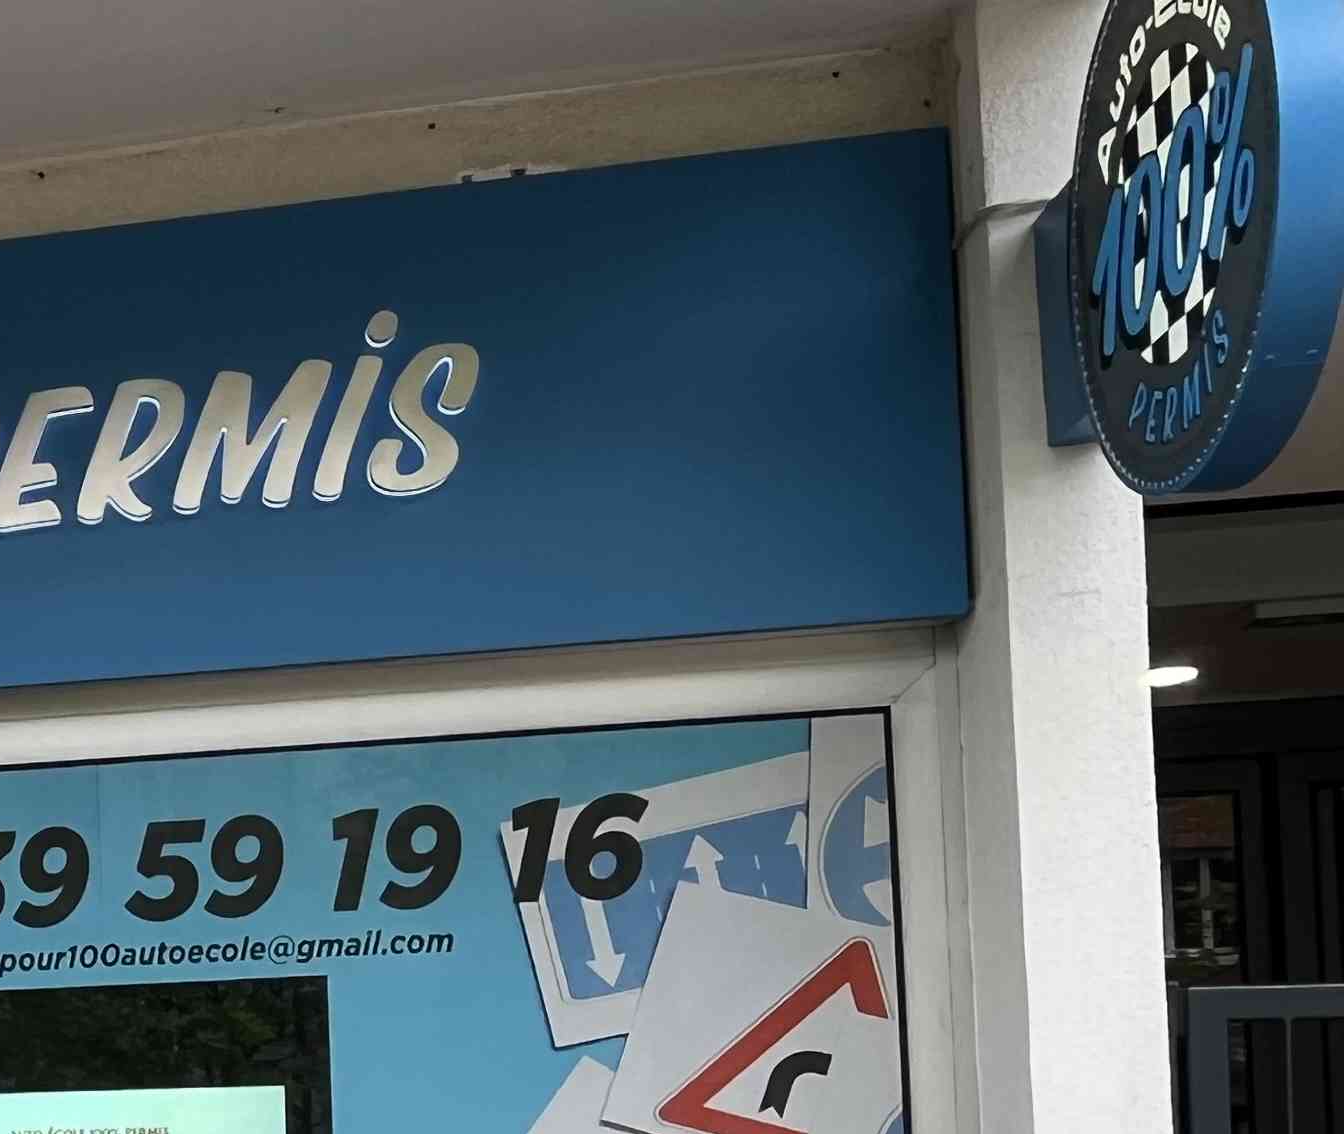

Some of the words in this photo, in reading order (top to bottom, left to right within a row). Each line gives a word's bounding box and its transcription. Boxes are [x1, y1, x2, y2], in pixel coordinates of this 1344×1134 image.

[1093, 42, 1255, 357] 100%
[124, 814, 284, 922] 59
[332, 804, 462, 912] 19
[512, 793, 650, 903] 16
